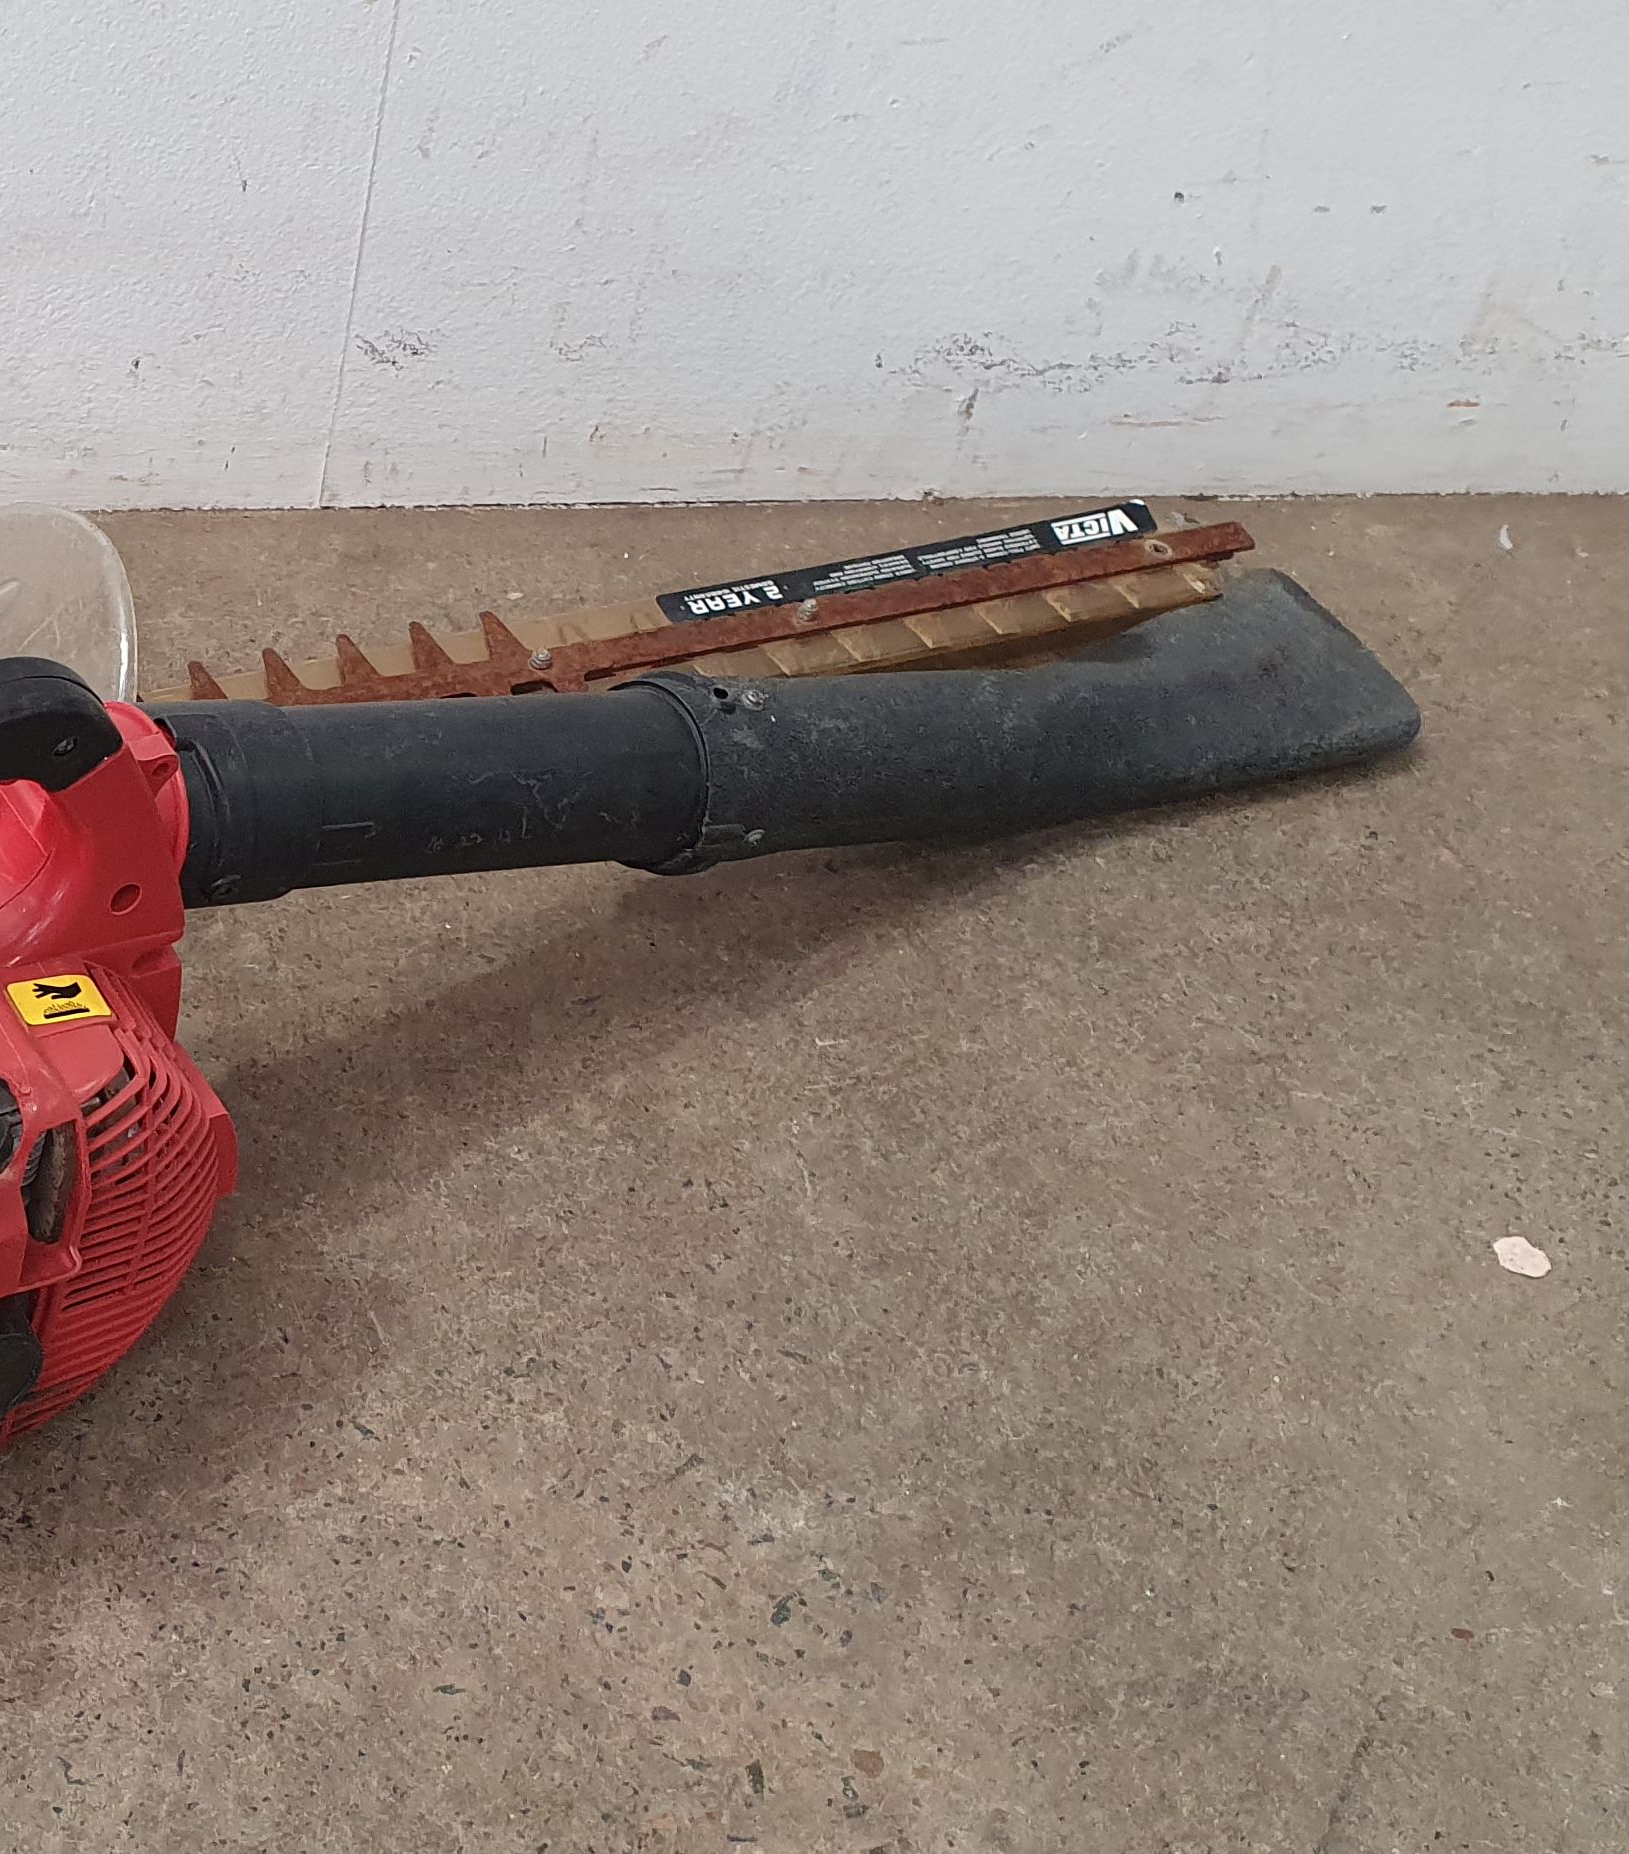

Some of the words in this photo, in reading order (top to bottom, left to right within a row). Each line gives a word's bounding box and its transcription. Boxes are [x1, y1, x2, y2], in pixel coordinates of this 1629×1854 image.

[1051, 508, 1139, 546] VICTA
[687, 590, 761, 615] YEAR
[762, 585, 784, 600] 2
